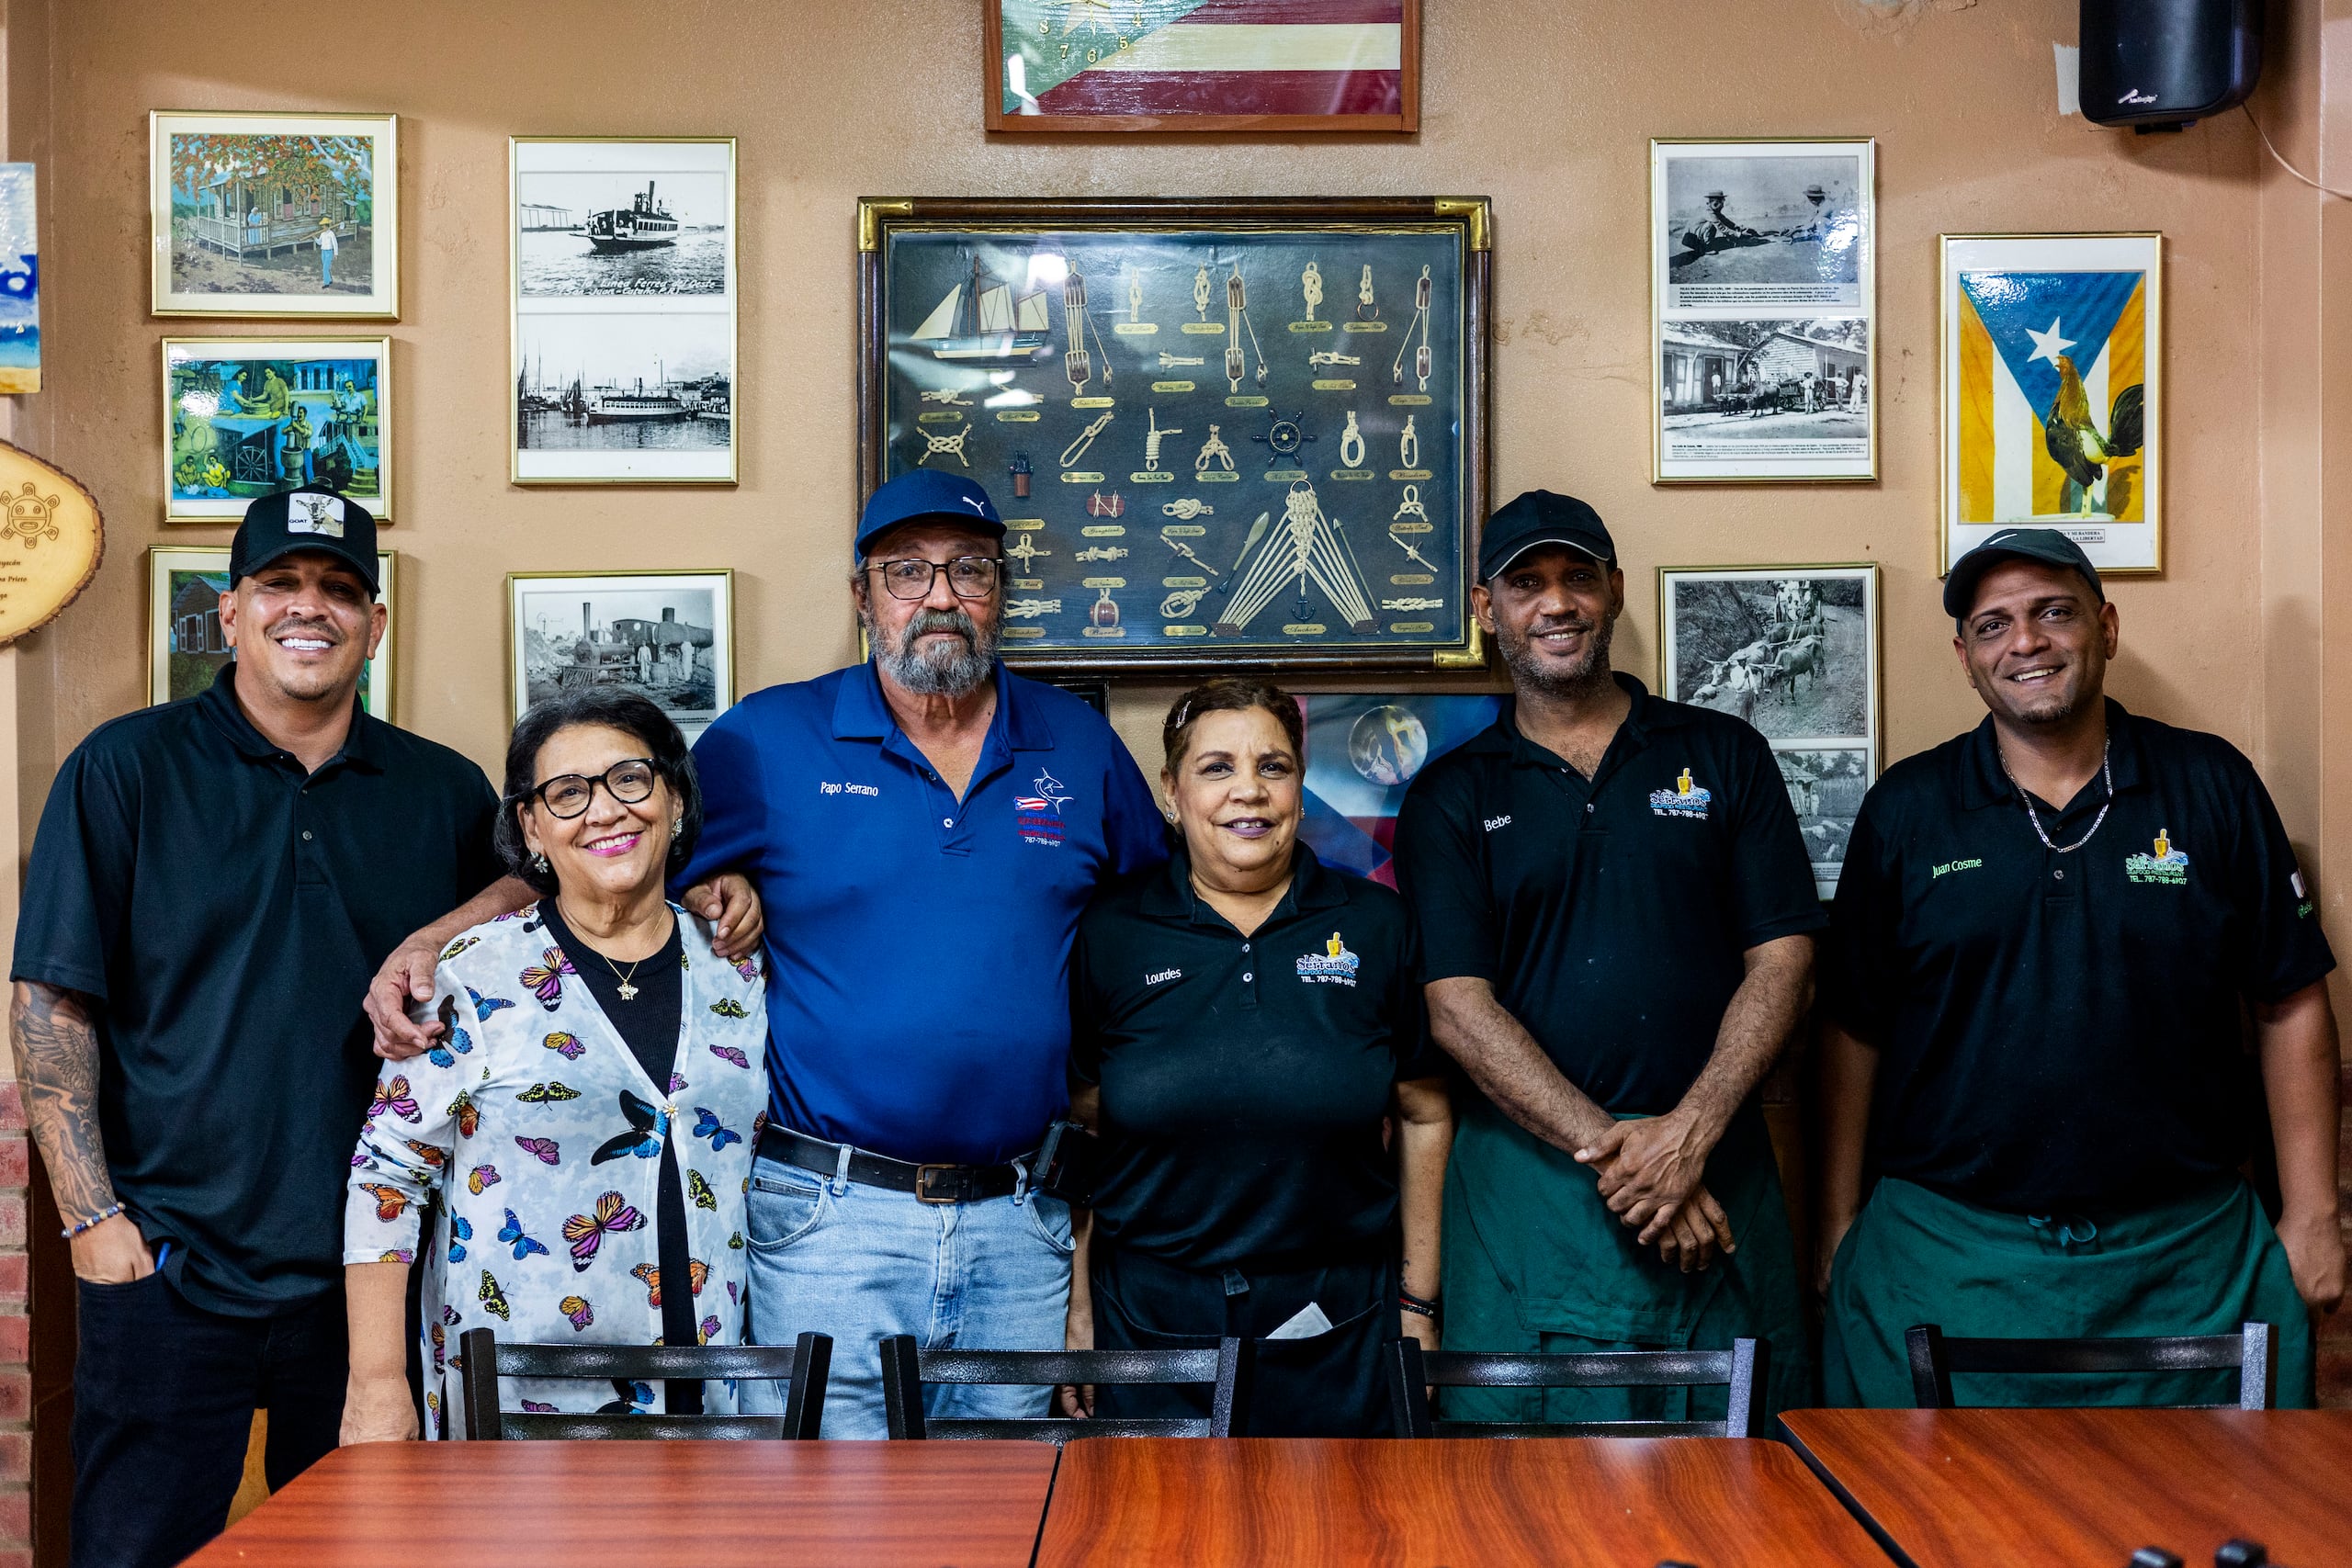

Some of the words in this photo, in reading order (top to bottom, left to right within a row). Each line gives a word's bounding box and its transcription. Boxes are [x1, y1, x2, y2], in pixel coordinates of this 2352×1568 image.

[1039, 19, 1050, 34] 8
[1131, 13, 1142, 28] 4
[1119, 36, 1129, 50] 5
[1059, 43, 1069, 59] 7
[1087, 49, 1097, 63] 6
[820, 782, 842, 795] Papo
[845, 782, 878, 796] Serrano
[1484, 815, 1512, 832] Bebe
[1932, 863, 1951, 879] Juan
[1951, 859, 1983, 872] Cosme
[1296, 957, 1356, 974] Serranos
[1145, 967, 1182, 986] Lourdes
